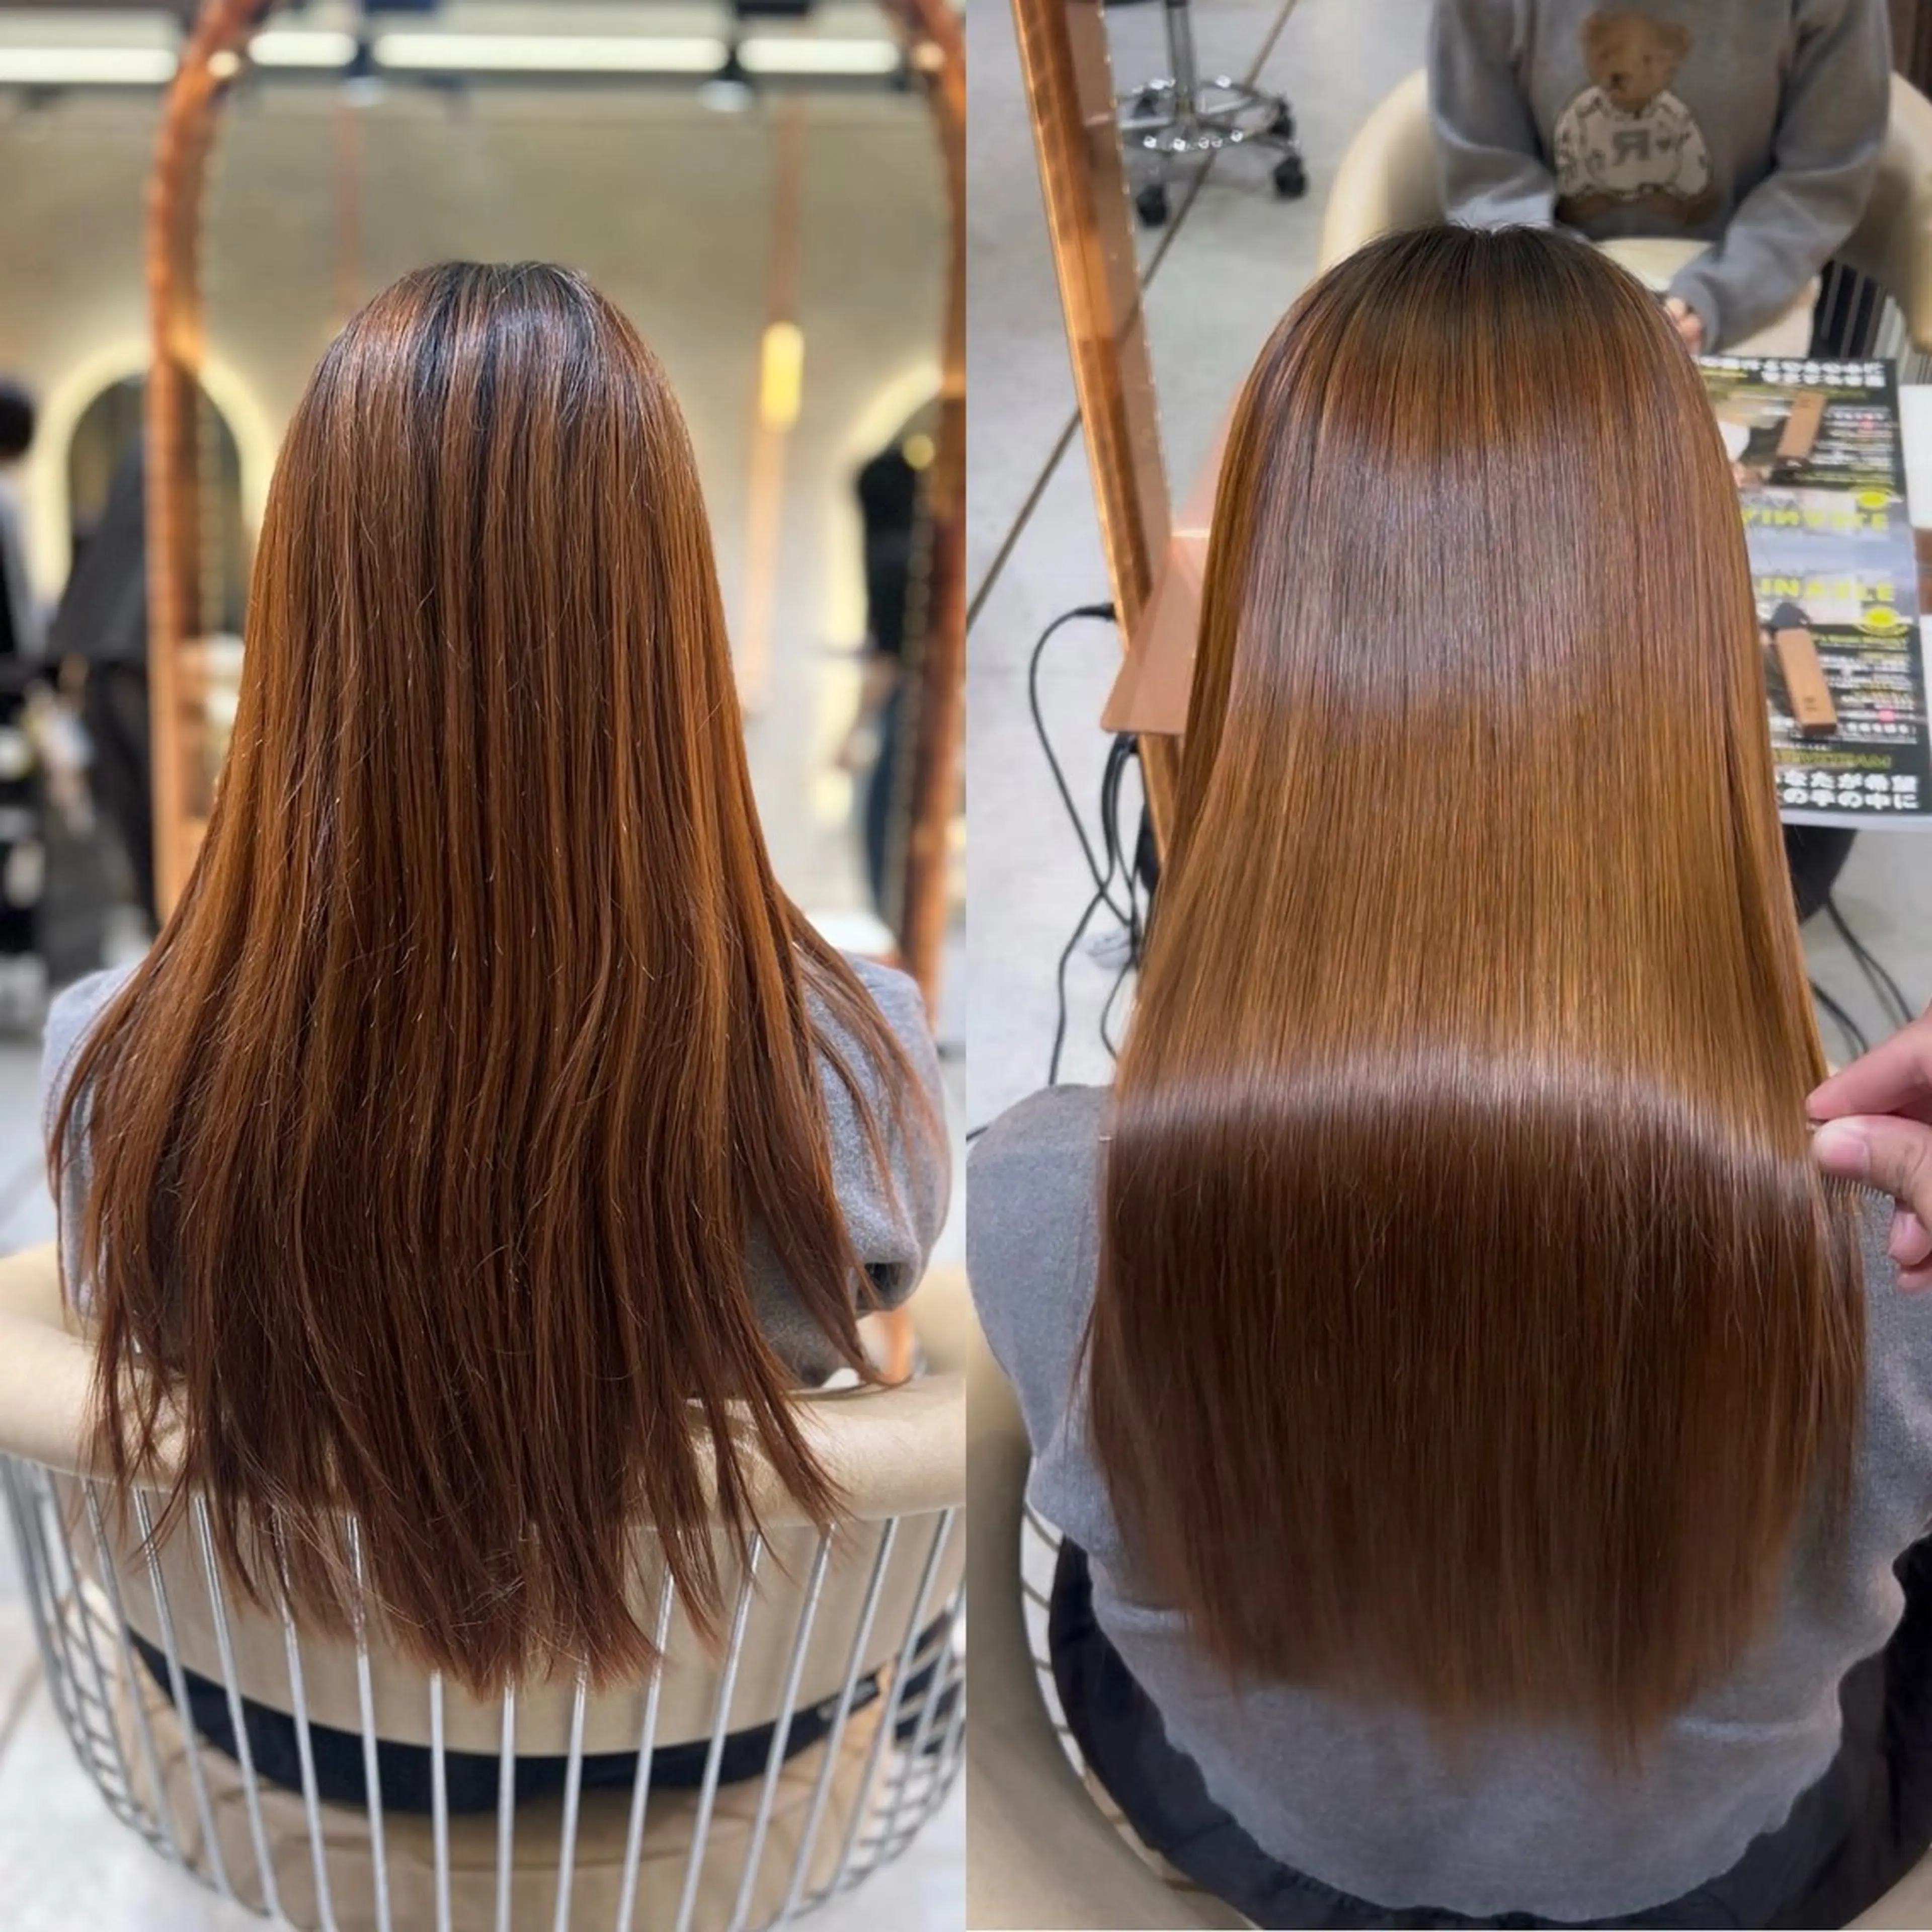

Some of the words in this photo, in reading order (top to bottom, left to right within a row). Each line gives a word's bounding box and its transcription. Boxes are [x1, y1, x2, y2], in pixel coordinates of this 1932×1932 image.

[1775, 787, 1919, 810] の手の中に
